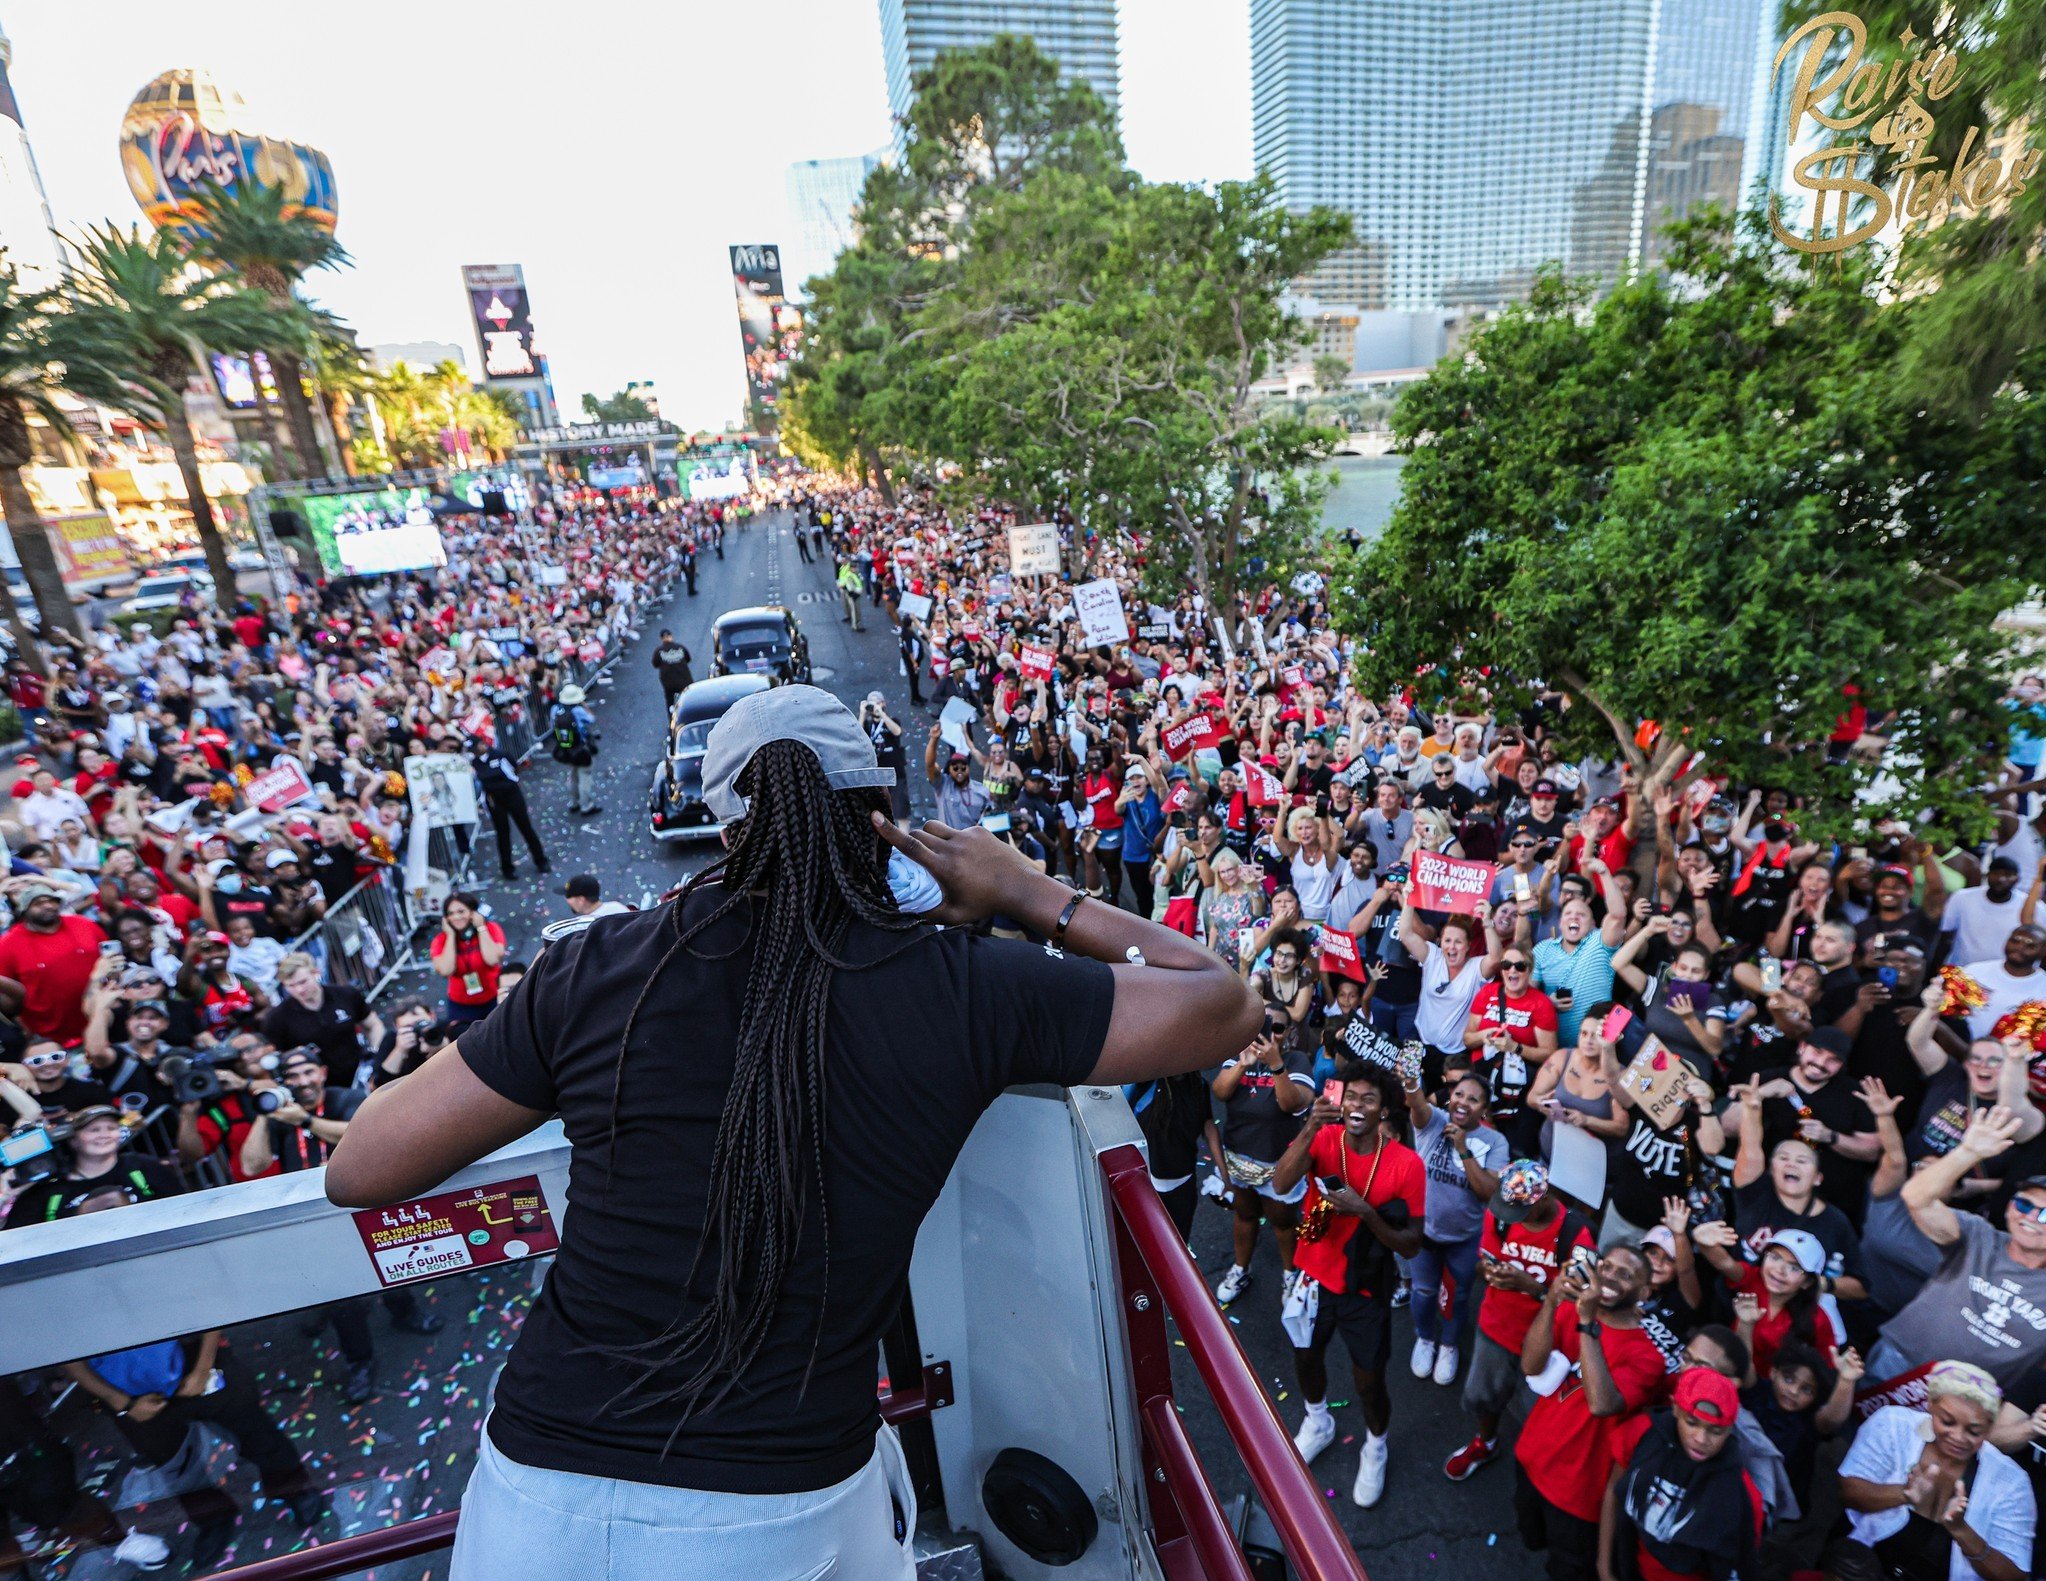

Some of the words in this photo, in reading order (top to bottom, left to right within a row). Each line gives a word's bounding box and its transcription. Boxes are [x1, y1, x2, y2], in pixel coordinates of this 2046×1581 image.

[529, 424, 603, 443] HISTORY
[607, 421, 659, 438] MADE
[1022, 543, 1046, 556] MUST
[1183, 715, 1210, 731] WORLD
[1169, 723, 1213, 749] CHAMPIONS
[1421, 856, 1448, 875] 2022
[1449, 863, 1488, 881] WORLD
[1416, 870, 1485, 895] CHAMPIONS
[1344, 1029, 1396, 1071] CHAMPION
[1347, 1018, 1376, 1046] 2022
[1374, 1036, 1402, 1063] WORL
[1620, 1068, 1639, 1089] Las
[1625, 1118, 1685, 1178] VOTE
[371, 1230, 390, 1240] FOR
[391, 1225, 414, 1235] YOUR
[416, 1217, 450, 1230] SAFETY
[373, 1234, 404, 1244] PLEASE
[403, 1229, 423, 1238] STAY
[424, 1222, 452, 1233] SEATED
[376, 1240, 392, 1249] AND
[393, 1235, 417, 1245] ENJOY
[418, 1231, 434, 1240] THE
[434, 1227, 454, 1236] TOUR
[385, 1261, 415, 1275] LIVE
[416, 1250, 464, 1268] GUIDES
[1501, 1241, 1519, 1257] AS
[1520, 1243, 1558, 1267] VEGA
[389, 1272, 405, 1280] ON
[406, 1267, 426, 1277] ALL
[426, 1258, 467, 1272] ROUTES
[1639, 1313, 1680, 1350] 2022
